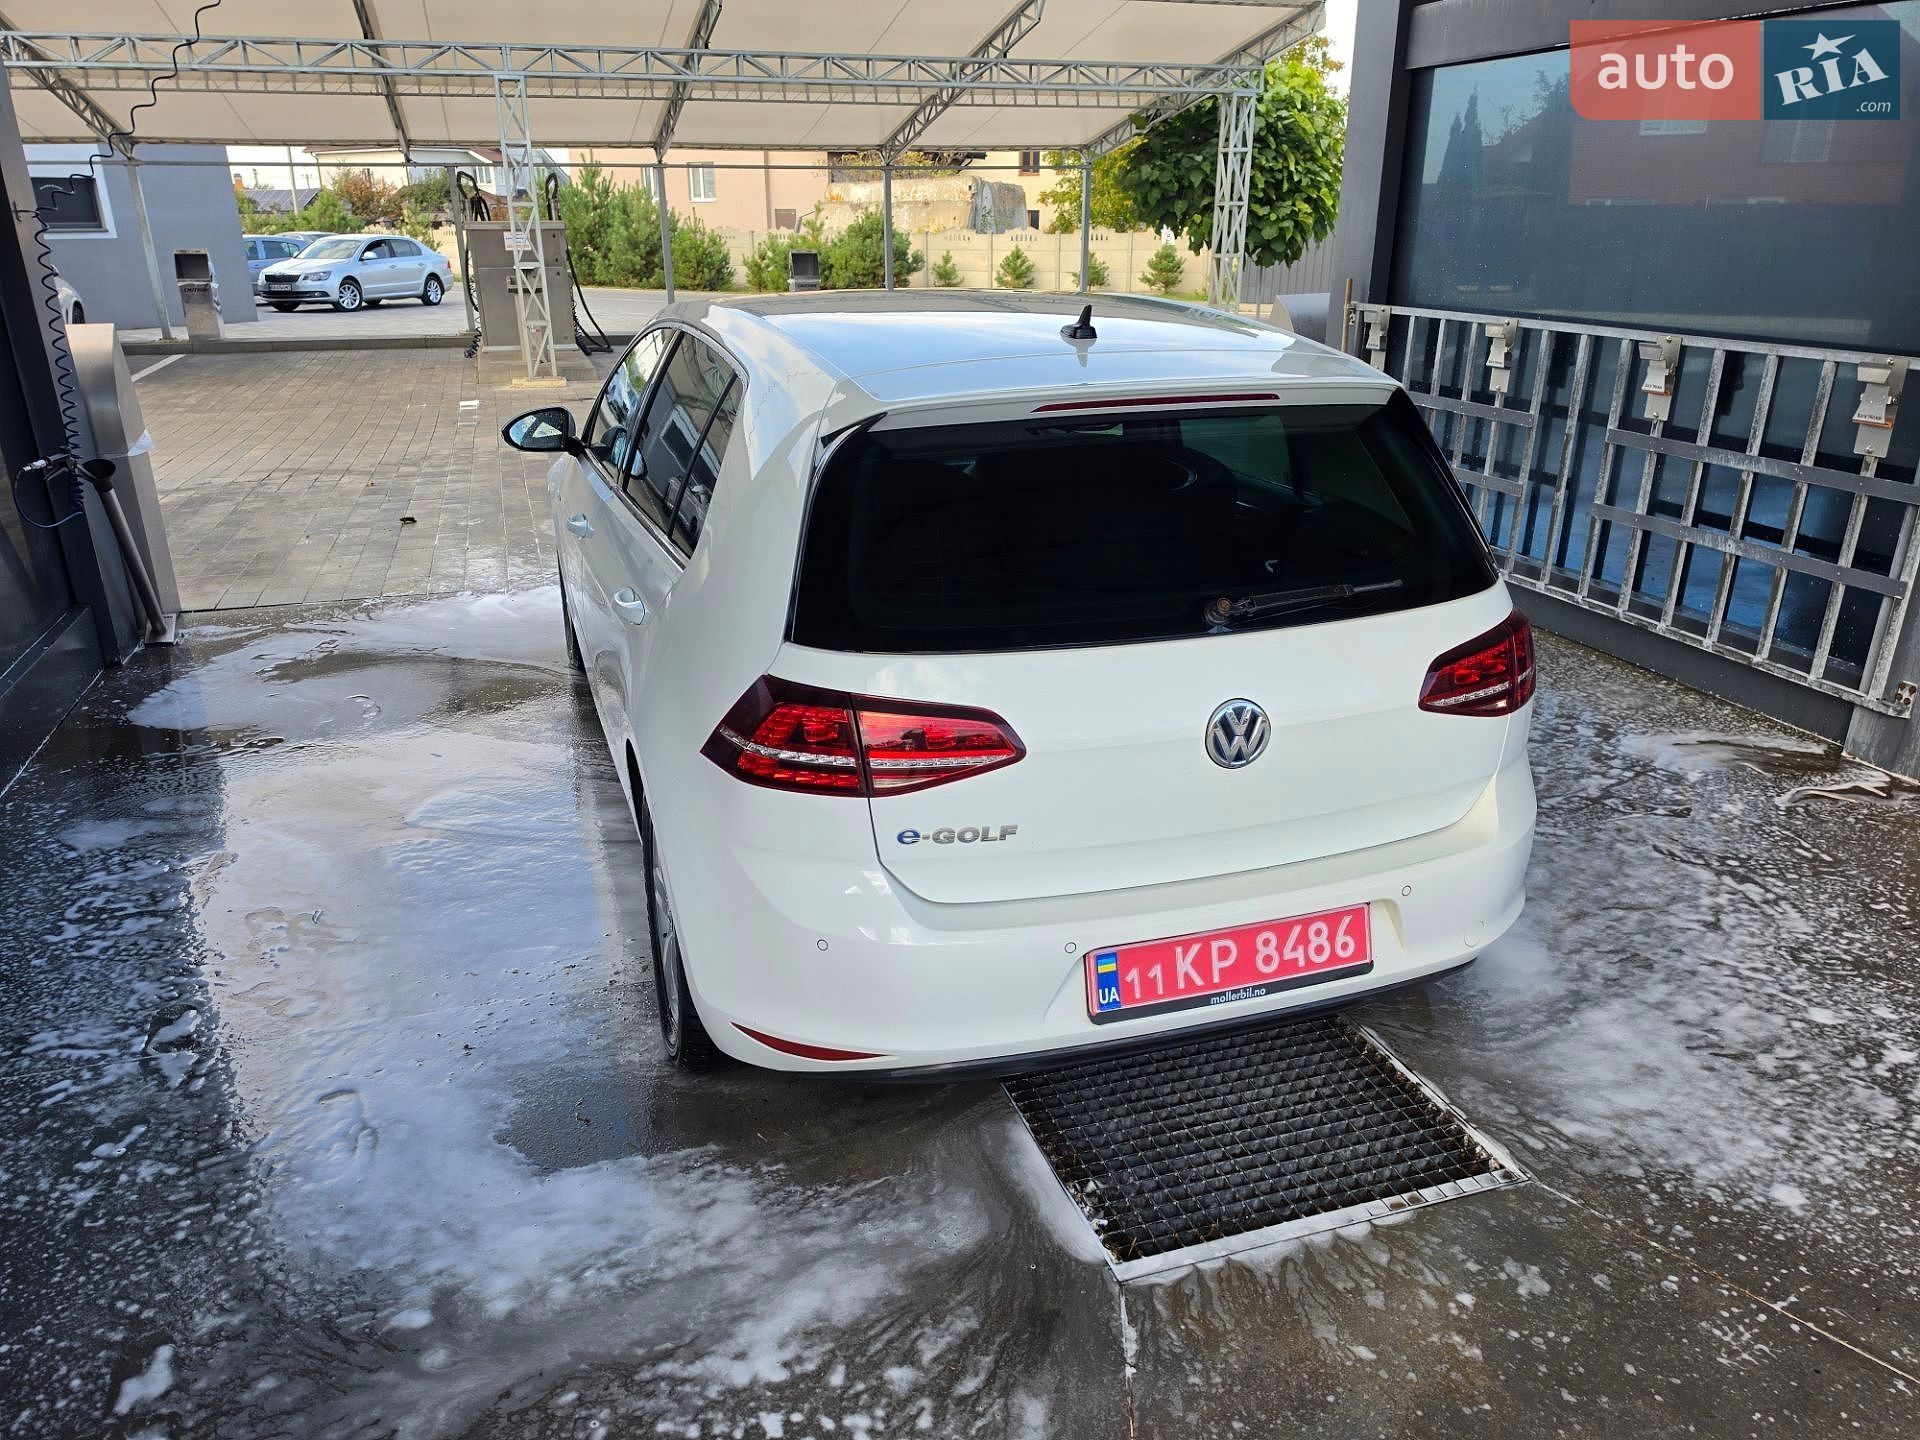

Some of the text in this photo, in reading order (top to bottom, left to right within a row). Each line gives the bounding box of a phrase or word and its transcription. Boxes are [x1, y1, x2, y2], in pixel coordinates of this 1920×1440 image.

[896, 824, 1018, 845] e-GOLF
[1124, 914, 1356, 1000] 11 KP 8486
[1099, 988, 1120, 1005] UA
[1210, 986, 1267, 1005] mollerbil.no
